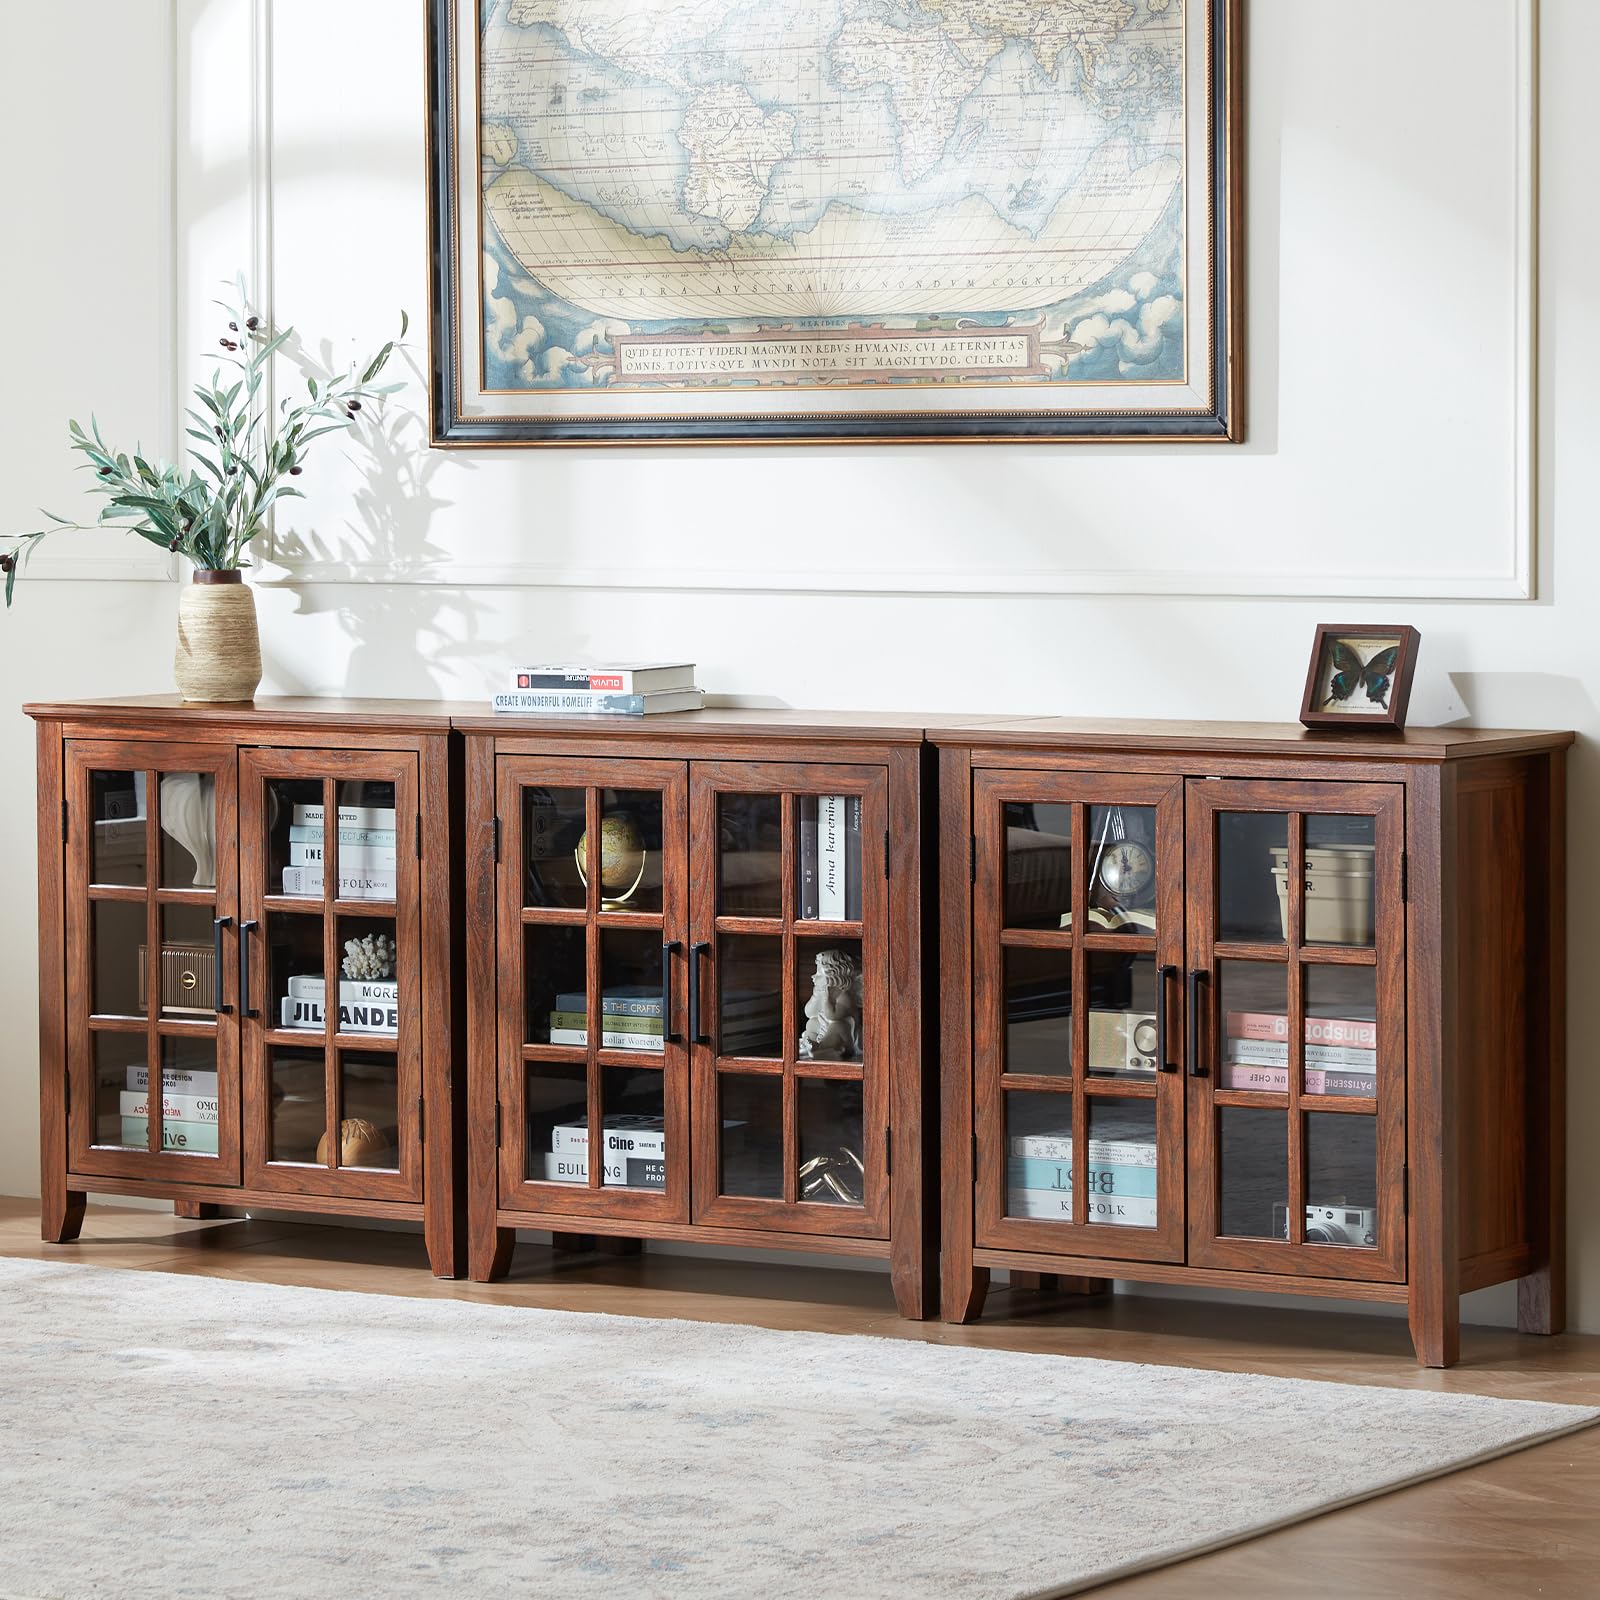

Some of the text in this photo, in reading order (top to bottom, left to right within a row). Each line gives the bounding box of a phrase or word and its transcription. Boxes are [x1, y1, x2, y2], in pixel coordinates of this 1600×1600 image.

[600, 276, 1082, 296] TERRA AVSTRALIS NONDVM COGNITA
[625, 348, 649, 358] QVID
[665, 347, 704, 357] POTEST
[708, 345, 748, 356] VIDERI
[752, 344, 798, 354] MAGNVM
[800, 344, 812, 354] IN
[816, 343, 850, 353] REBVS
[916, 342, 935, 352] CVI
[942, 340, 1024, 351] AETERNITAS
[752, 358, 796, 368] MVNDI
[802, 358, 837, 367] NOTA
[845, 357, 868, 367] SIT
[592, 678, 620, 686] OLIVIA
[495, 695, 593, 708] CREATE WONDERFUL HOMELIFE
[322, 878, 373, 889] FOLK
[826, 860, 836, 896] Anna
[610, 1002, 627, 1012] THE
[630, 1004, 660, 1014] CRAFTS
[294, 1002, 398, 1028] JIL ANDE
[628, 1036, 661, 1047] Women's
[1249, 1074, 1270, 1082] CHEF
[608, 1136, 635, 1150] Cine
[558, 1162, 621, 1178] BUILNG
[1060, 1200, 1126, 1216] KFOLK
